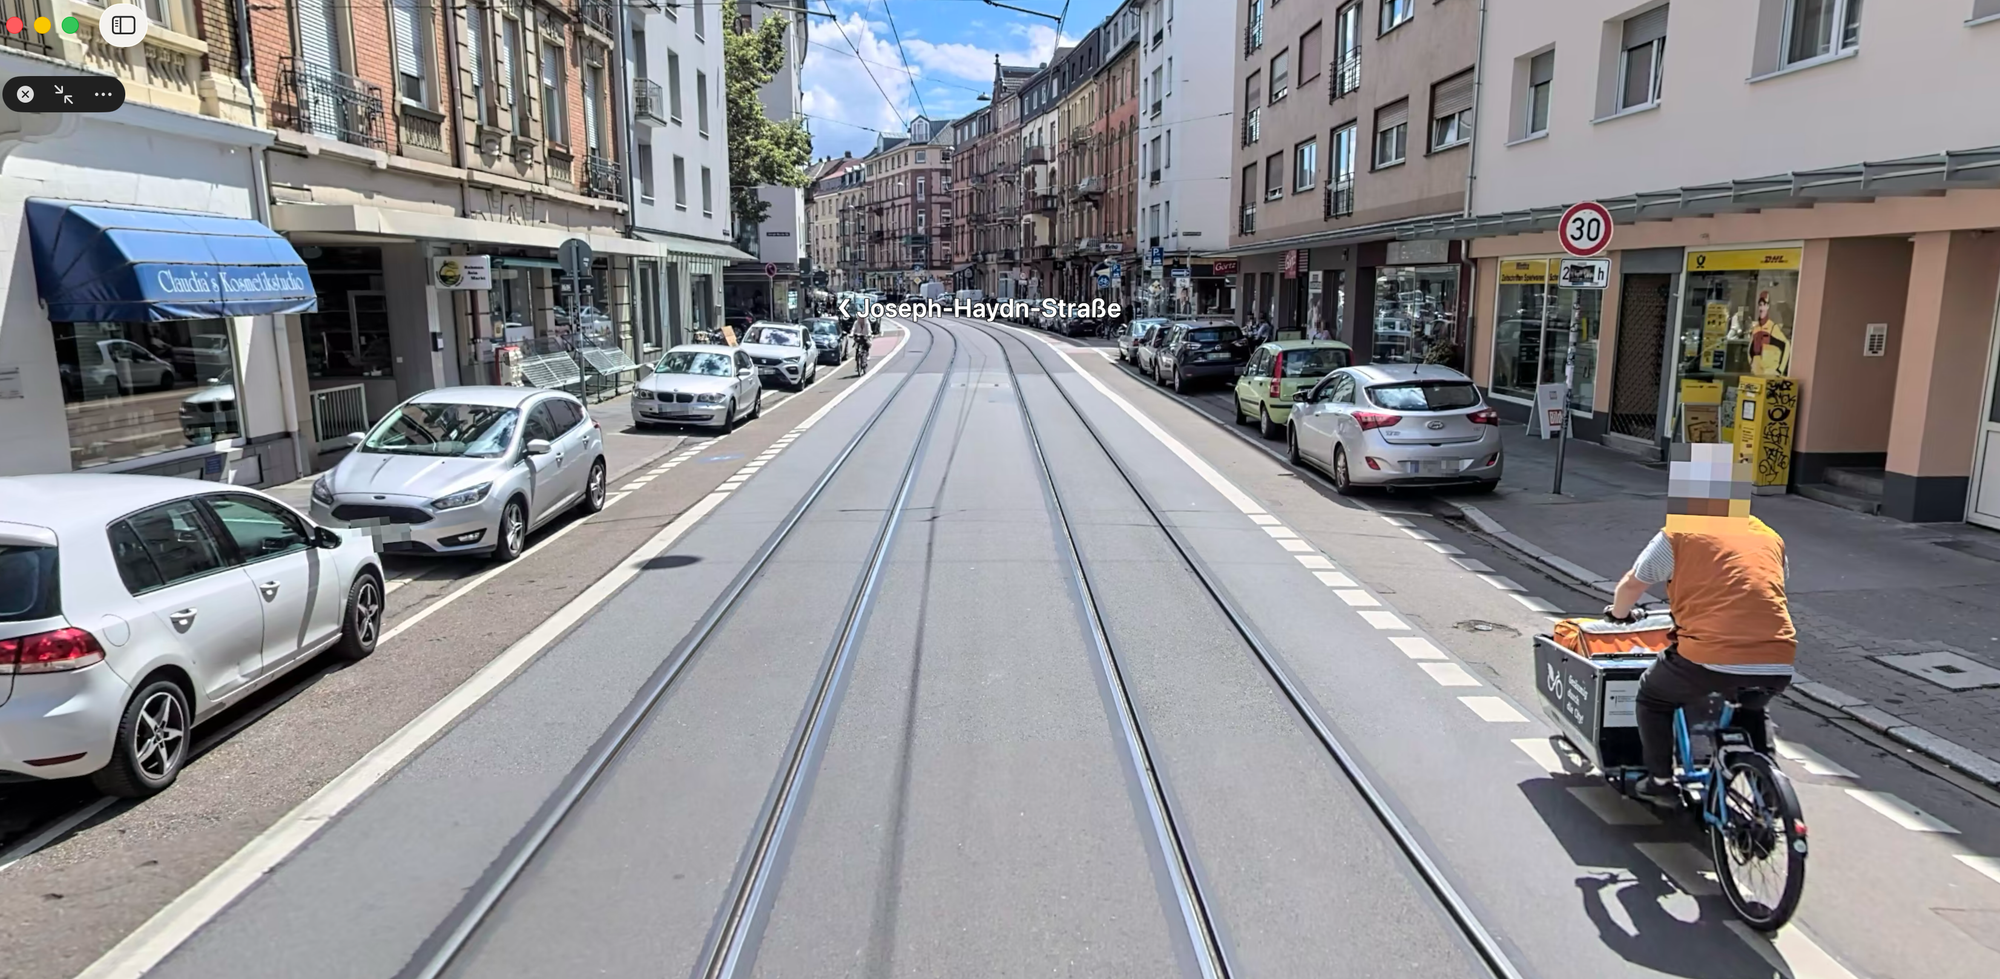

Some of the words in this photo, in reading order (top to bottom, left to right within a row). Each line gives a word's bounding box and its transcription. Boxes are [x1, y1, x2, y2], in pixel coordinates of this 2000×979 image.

[1569, 217, 1601, 242] 30
[1215, 261, 1237, 272] Görtz
[1764, 255, 1785, 264] DHL
[157, 268, 220, 293] Claudia's
[219, 270, 305, 293] Kosmetikstudio
